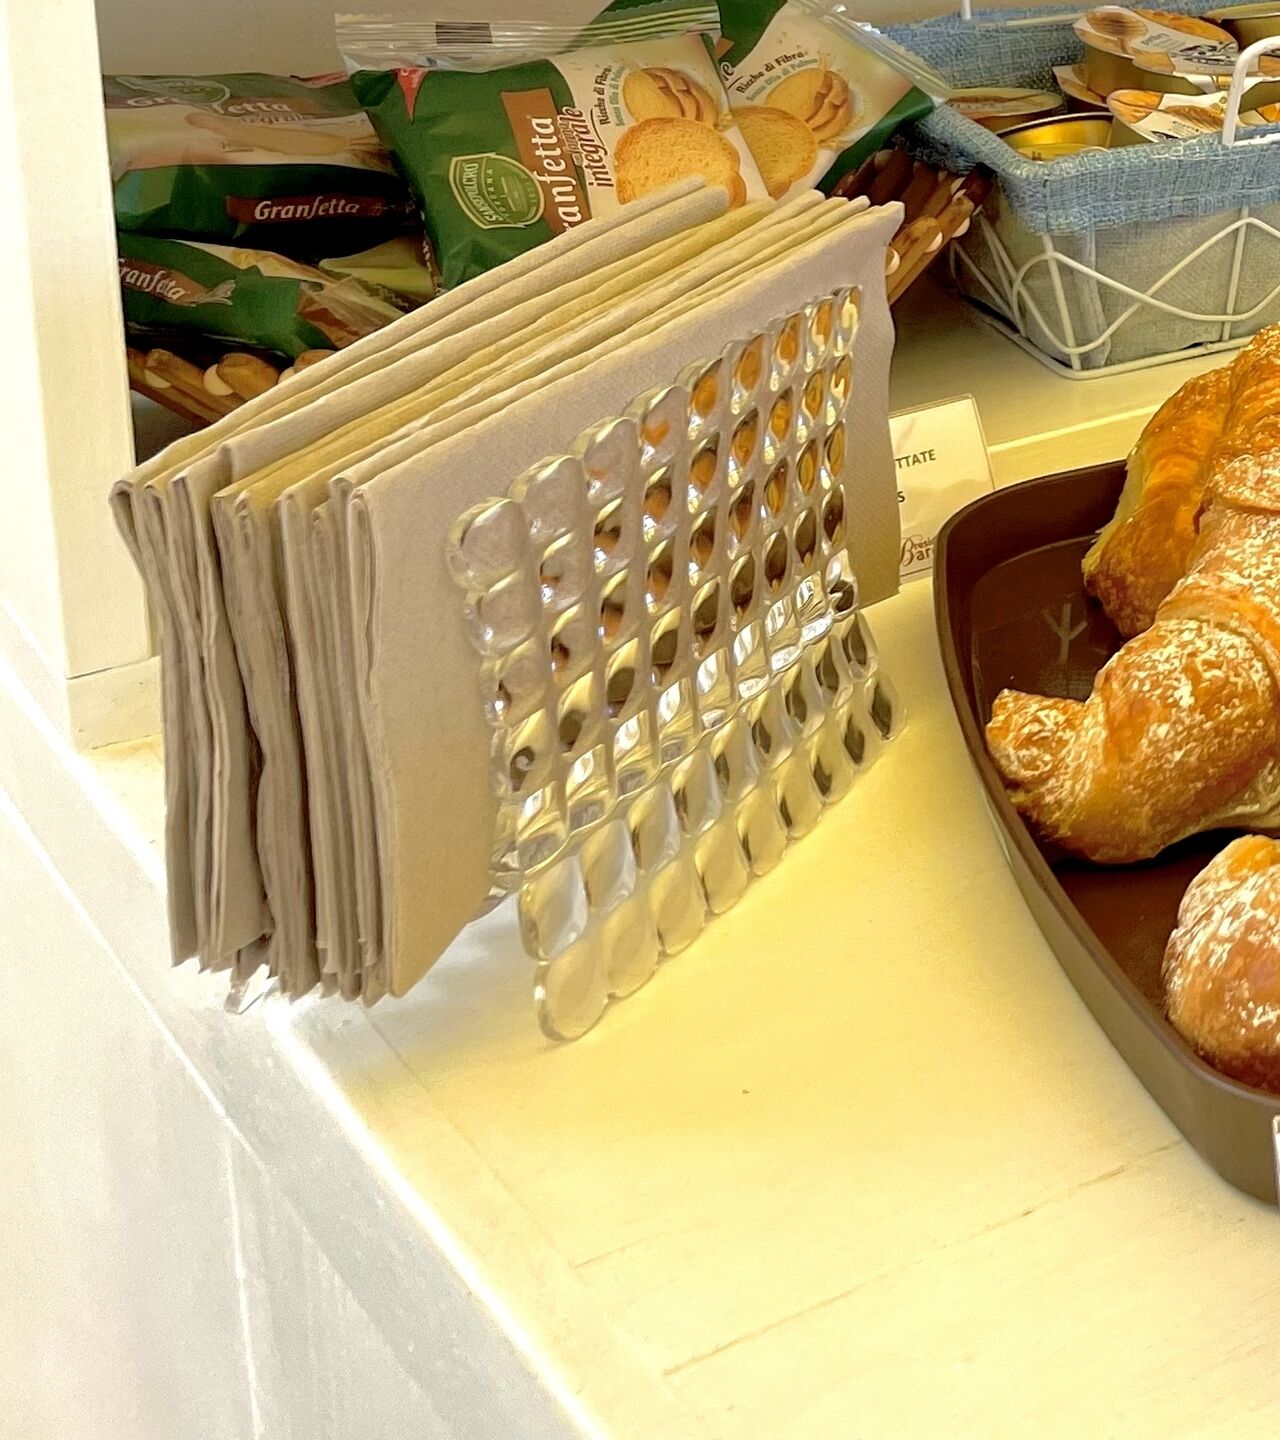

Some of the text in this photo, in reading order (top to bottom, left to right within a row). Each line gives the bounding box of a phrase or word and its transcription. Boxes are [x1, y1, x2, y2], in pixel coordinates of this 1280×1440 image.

[560, 106, 614, 188] integrale
[531, 115, 583, 232] anfetta
[254, 196, 360, 220] Granfetta
[120, 266, 186, 300] ranfetta
[900, 536, 933, 567] Bar
